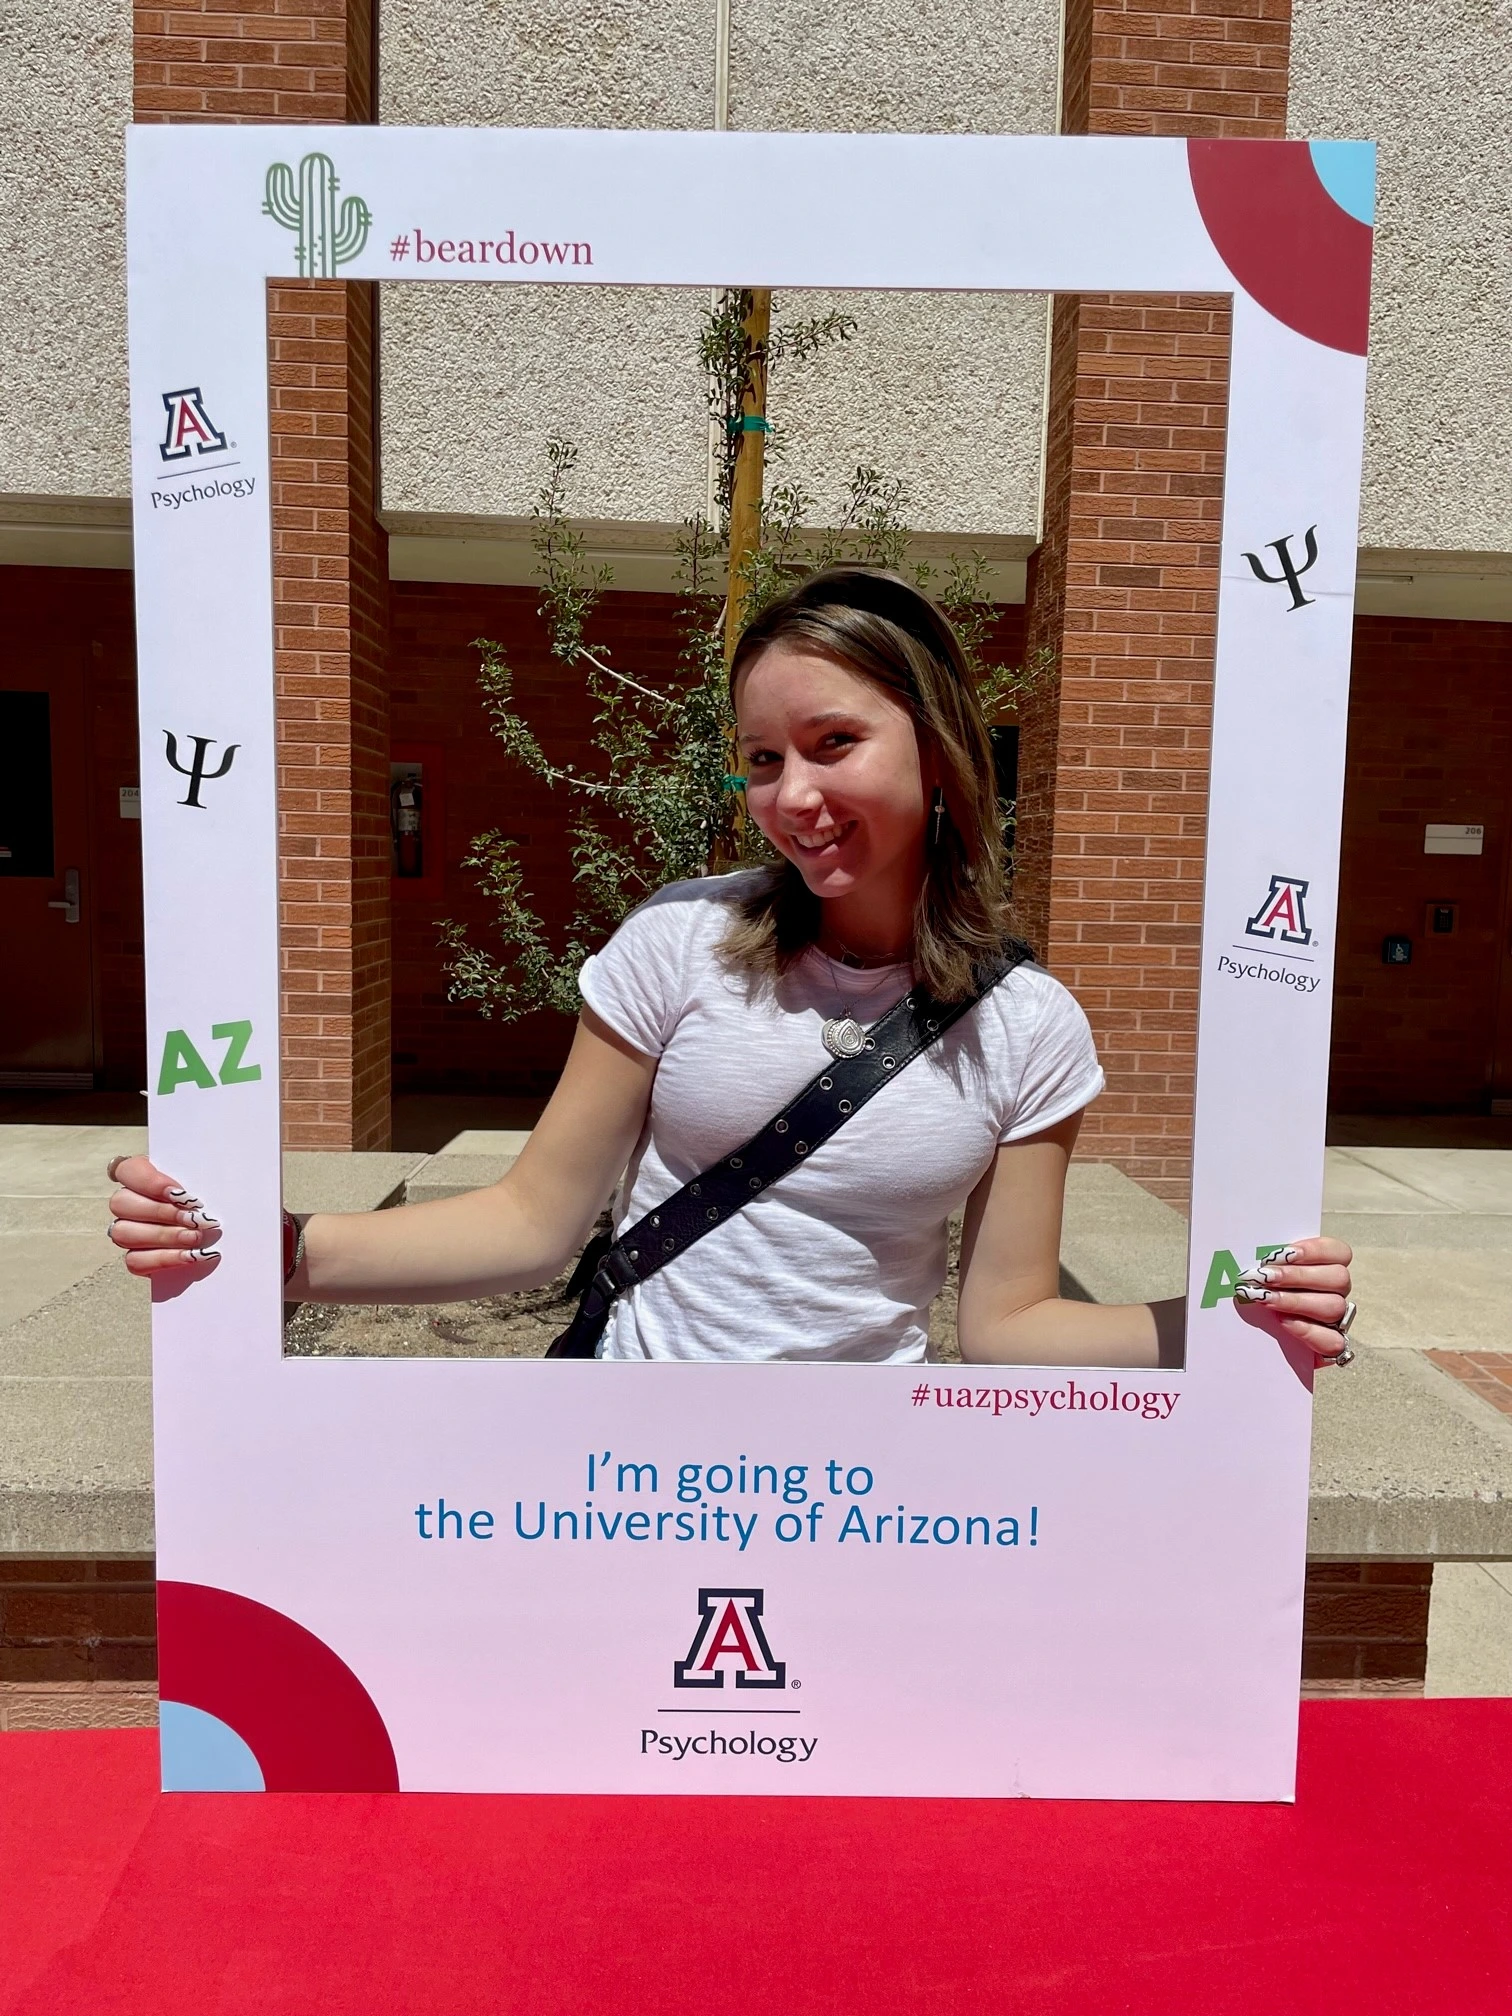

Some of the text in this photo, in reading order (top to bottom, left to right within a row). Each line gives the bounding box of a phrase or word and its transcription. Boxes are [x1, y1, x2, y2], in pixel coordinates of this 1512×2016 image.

[390, 229, 594, 266] #beardown
[151, 475, 256, 510] Psychology
[1465, 826, 1482, 836] 206
[1217, 955, 1321, 993] Psychology
[157, 1020, 262, 1096] AZ
[911, 1381, 1181, 1419] #uazpsychology
[677, 1455, 808, 1503] going
[825, 1460, 874, 1496] to
[415, 1499, 1038, 1551] the University of Arizona!
[640, 1730, 819, 1763] Psychology
